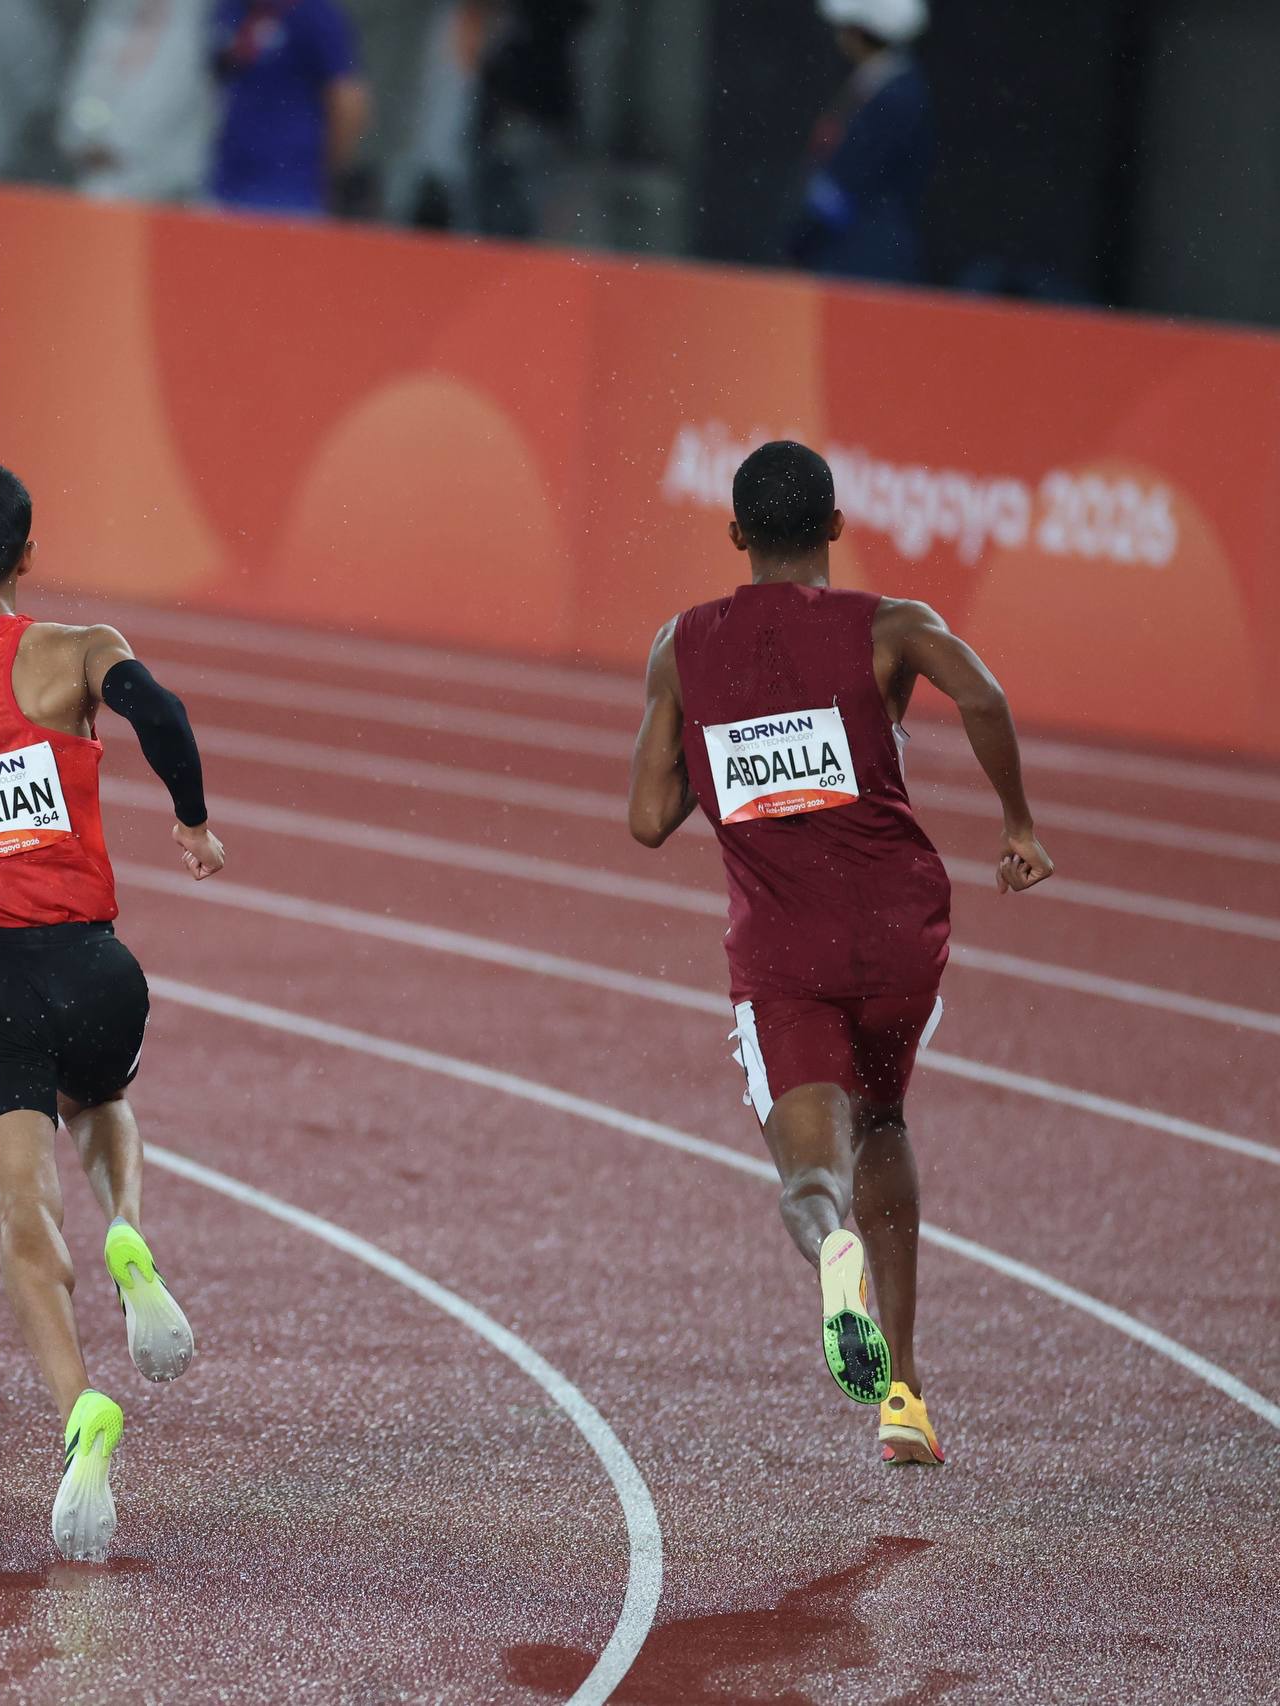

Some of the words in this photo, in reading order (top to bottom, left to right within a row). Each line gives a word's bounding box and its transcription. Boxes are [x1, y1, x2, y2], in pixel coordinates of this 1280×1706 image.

[1038, 470, 1176, 566] 2026
[728, 716, 814, 744] BORNAN
[726, 742, 842, 789] ABDALLA
[819, 773, 846, 788] 609
[33, 810, 59, 827] 364
[22, 837, 40, 847] 2026
